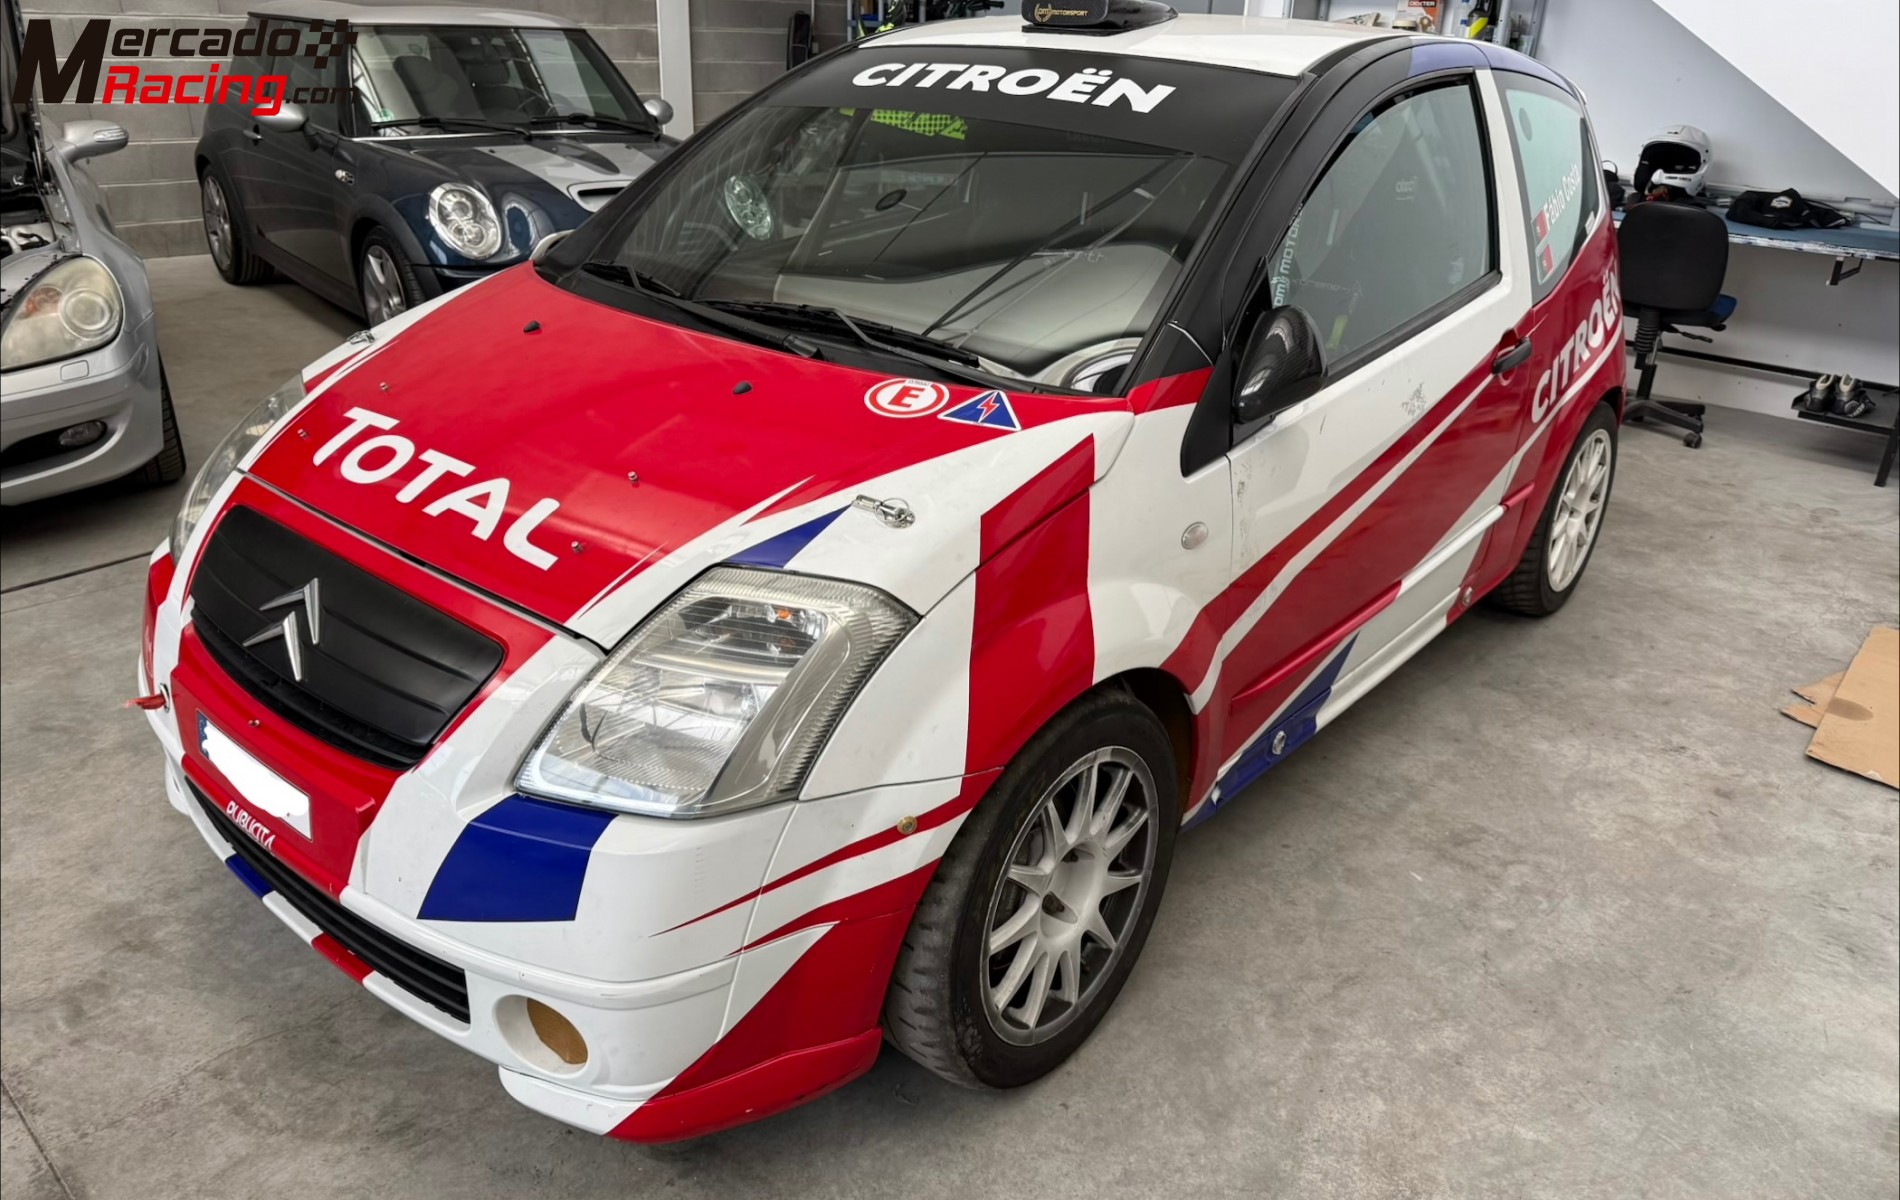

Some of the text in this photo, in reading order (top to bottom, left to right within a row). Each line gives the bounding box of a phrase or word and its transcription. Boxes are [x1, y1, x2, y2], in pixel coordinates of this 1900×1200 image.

[852, 63, 1176, 113] CITROËN
[1543, 163, 1580, 224] Fábio Costa
[1532, 268, 1621, 423] CITROËN
[888, 386, 925, 408] E
[313, 407, 560, 571] TOTAL
